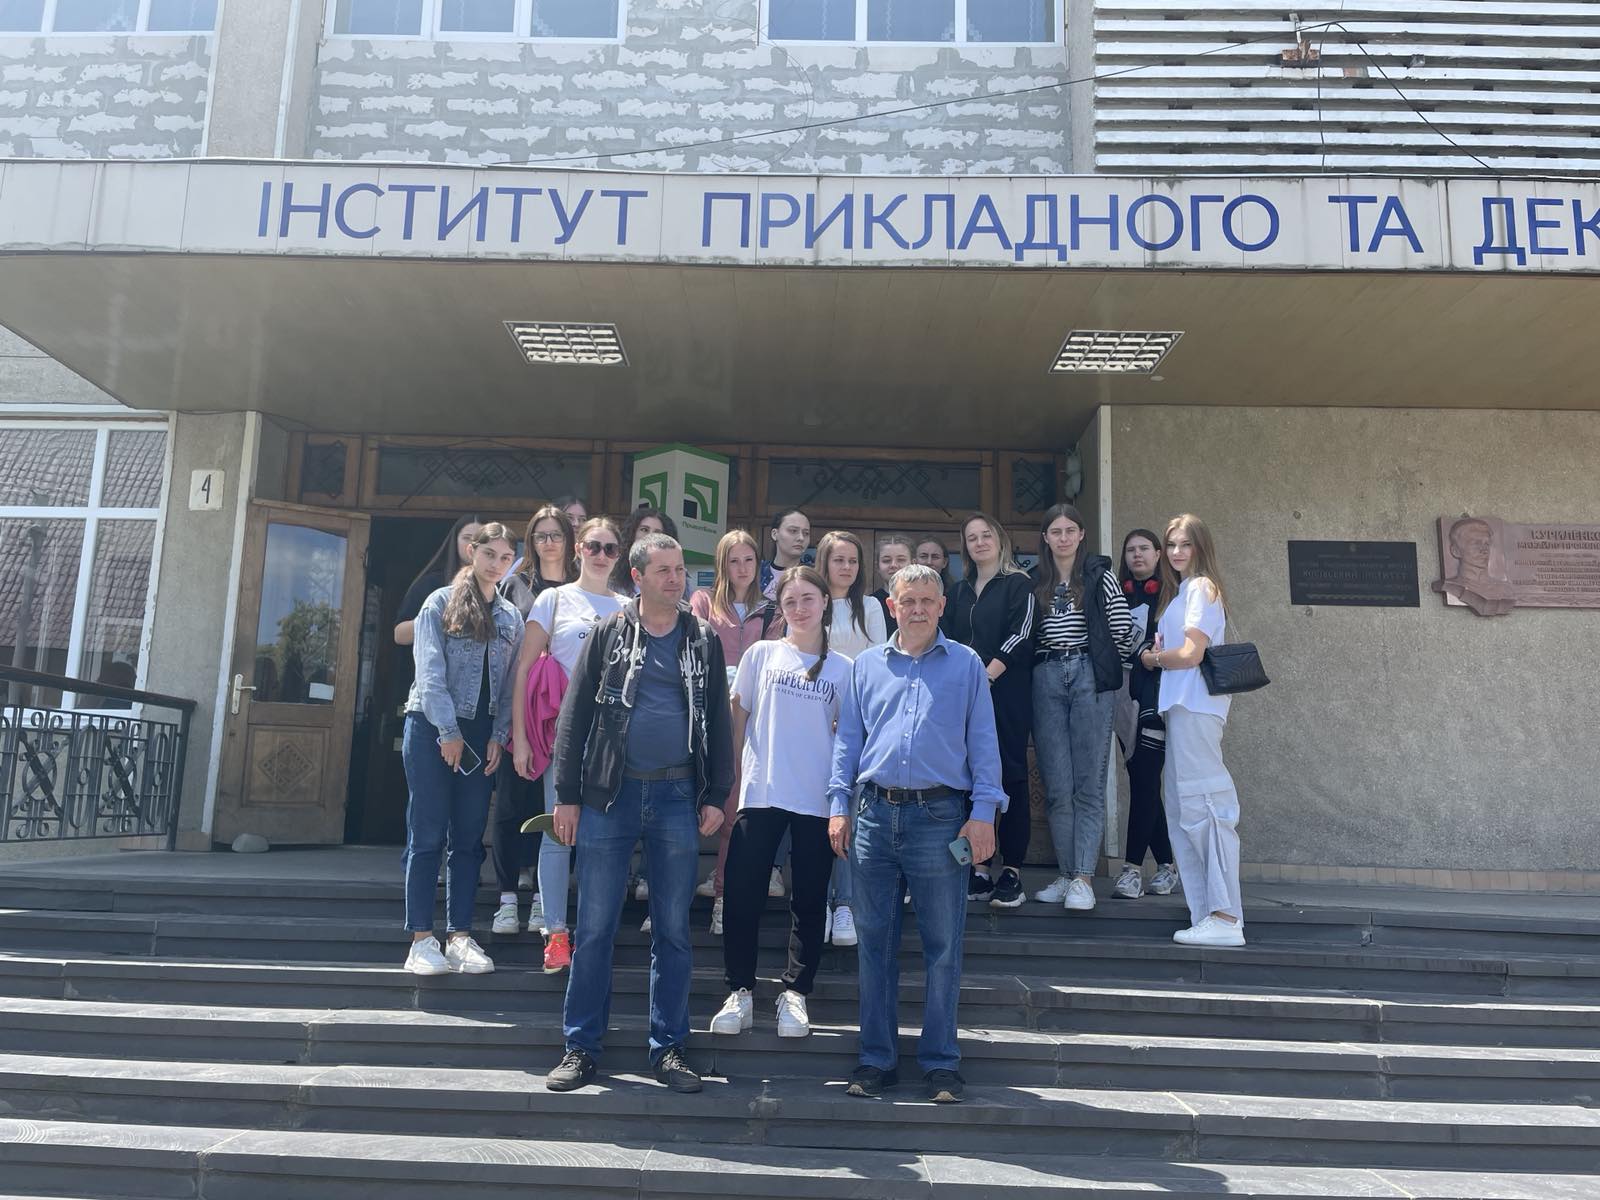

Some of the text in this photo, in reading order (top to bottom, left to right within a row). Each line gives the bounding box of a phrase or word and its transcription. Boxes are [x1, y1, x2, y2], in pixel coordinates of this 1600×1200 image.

[257, 182, 648, 245] ІНСТИТУТ
[701, 191, 1280, 262] ПРИКЛАДНОГО
[1327, 194, 1424, 254] ТА
[201, 473, 212, 504] 4
